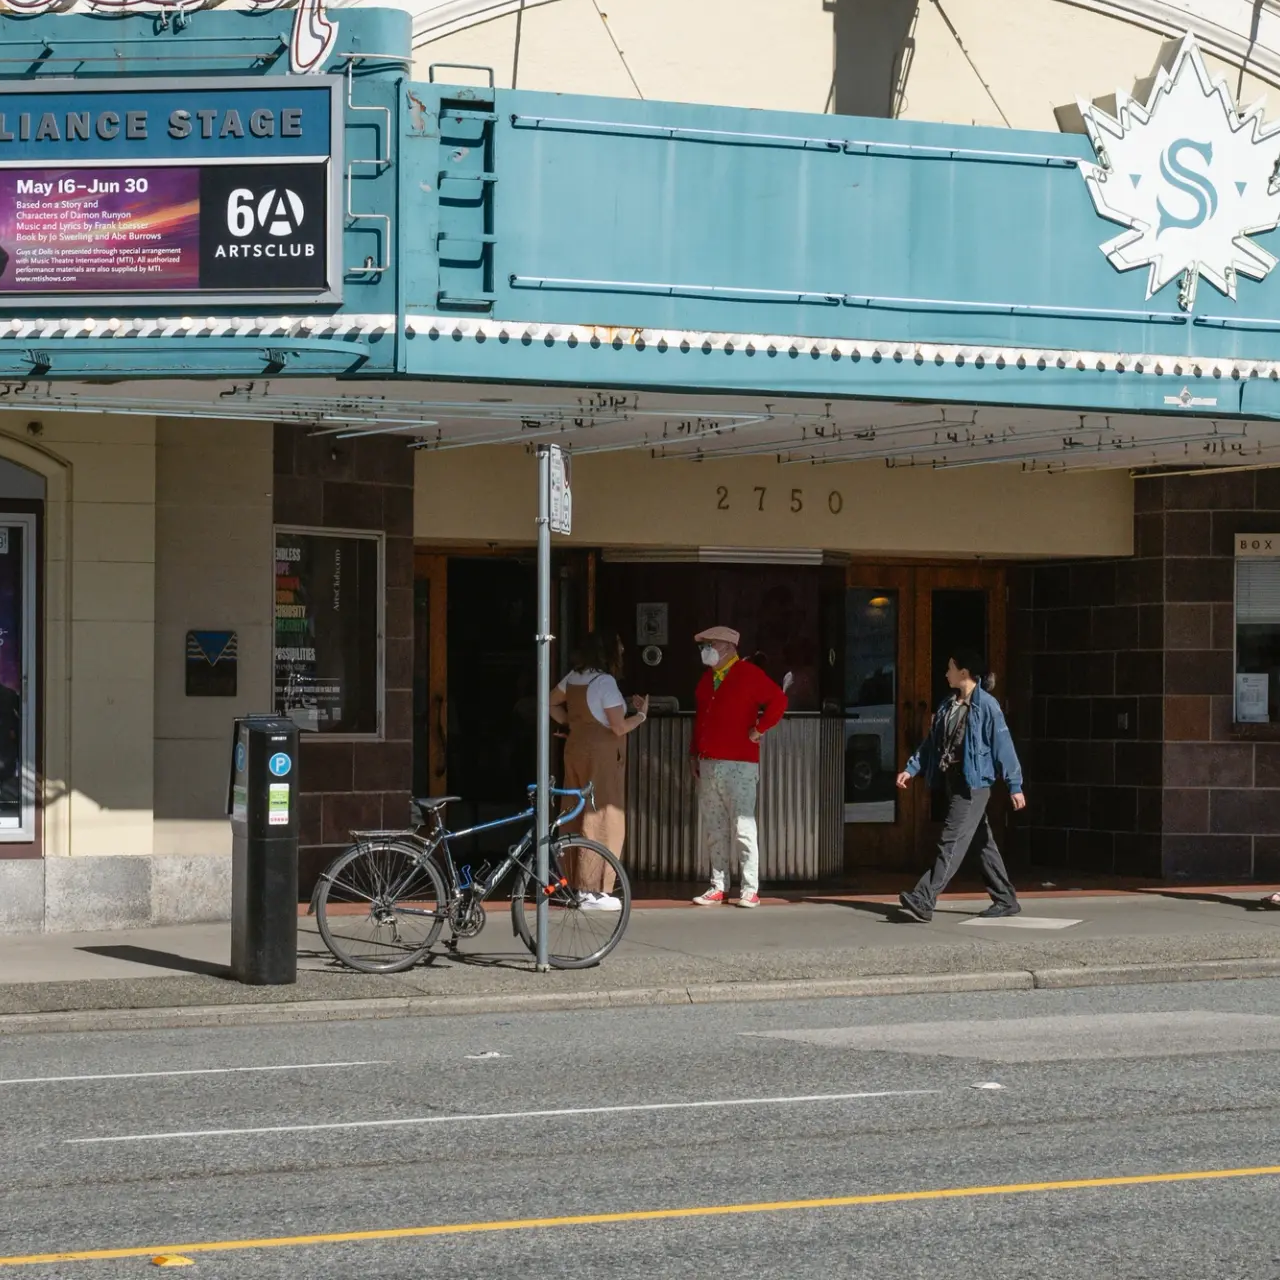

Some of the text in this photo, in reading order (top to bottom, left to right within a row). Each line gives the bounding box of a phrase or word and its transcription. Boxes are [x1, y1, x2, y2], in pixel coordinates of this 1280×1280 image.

[168, 108, 303, 139] STAGE
[16, 179, 52, 196] May
[125, 178, 148, 193] 30
[17, 201, 40, 209] Based
[62, 201, 81, 210] Story
[17, 211, 131, 220] Characters of Damon Runyon
[17, 222, 40, 230] Music
[43, 222, 57, 230] and
[59, 222, 81, 231] Lyrics
[83, 222, 92, 231] by
[38, 233, 47, 242] by
[49, 233, 57, 242] Jo
[59, 233, 92, 242] Swerling
[95, 232, 109, 240] and
[112, 232, 127, 240] Abe
[129, 232, 161, 240] Burrows
[61, 248, 91, 256] presented
[93, 248, 117, 256] through
[215, 244, 315, 258] ARTSCLUB
[16, 266, 54, 274] performance
[715, 485, 844, 515] 2750
[1240, 540, 1272, 550] BOX
